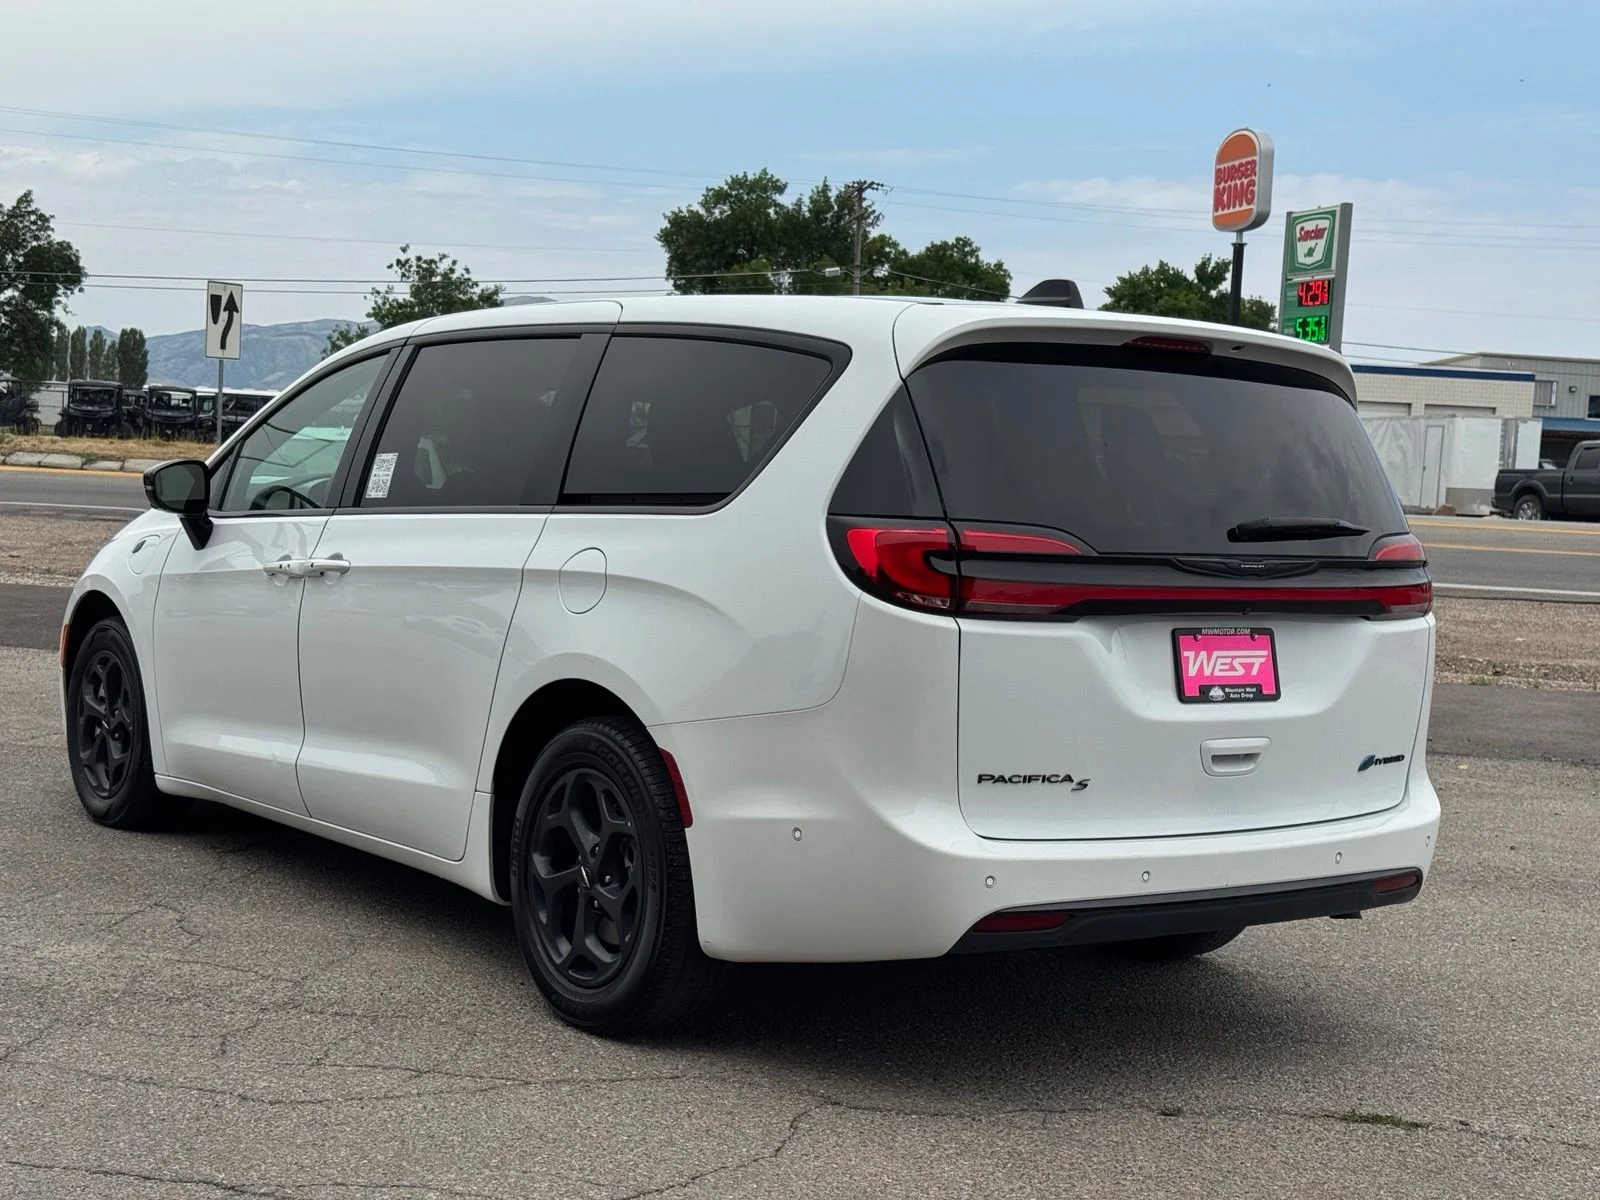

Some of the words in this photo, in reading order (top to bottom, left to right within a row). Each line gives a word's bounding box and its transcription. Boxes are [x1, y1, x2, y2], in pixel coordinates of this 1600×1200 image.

[1215, 159, 1257, 186] BURGER
[1214, 179, 1256, 213] KING
[1298, 224, 1327, 242] Sinclair
[977, 773, 1075, 785] PACIFICA
[1070, 778, 1091, 792] S
